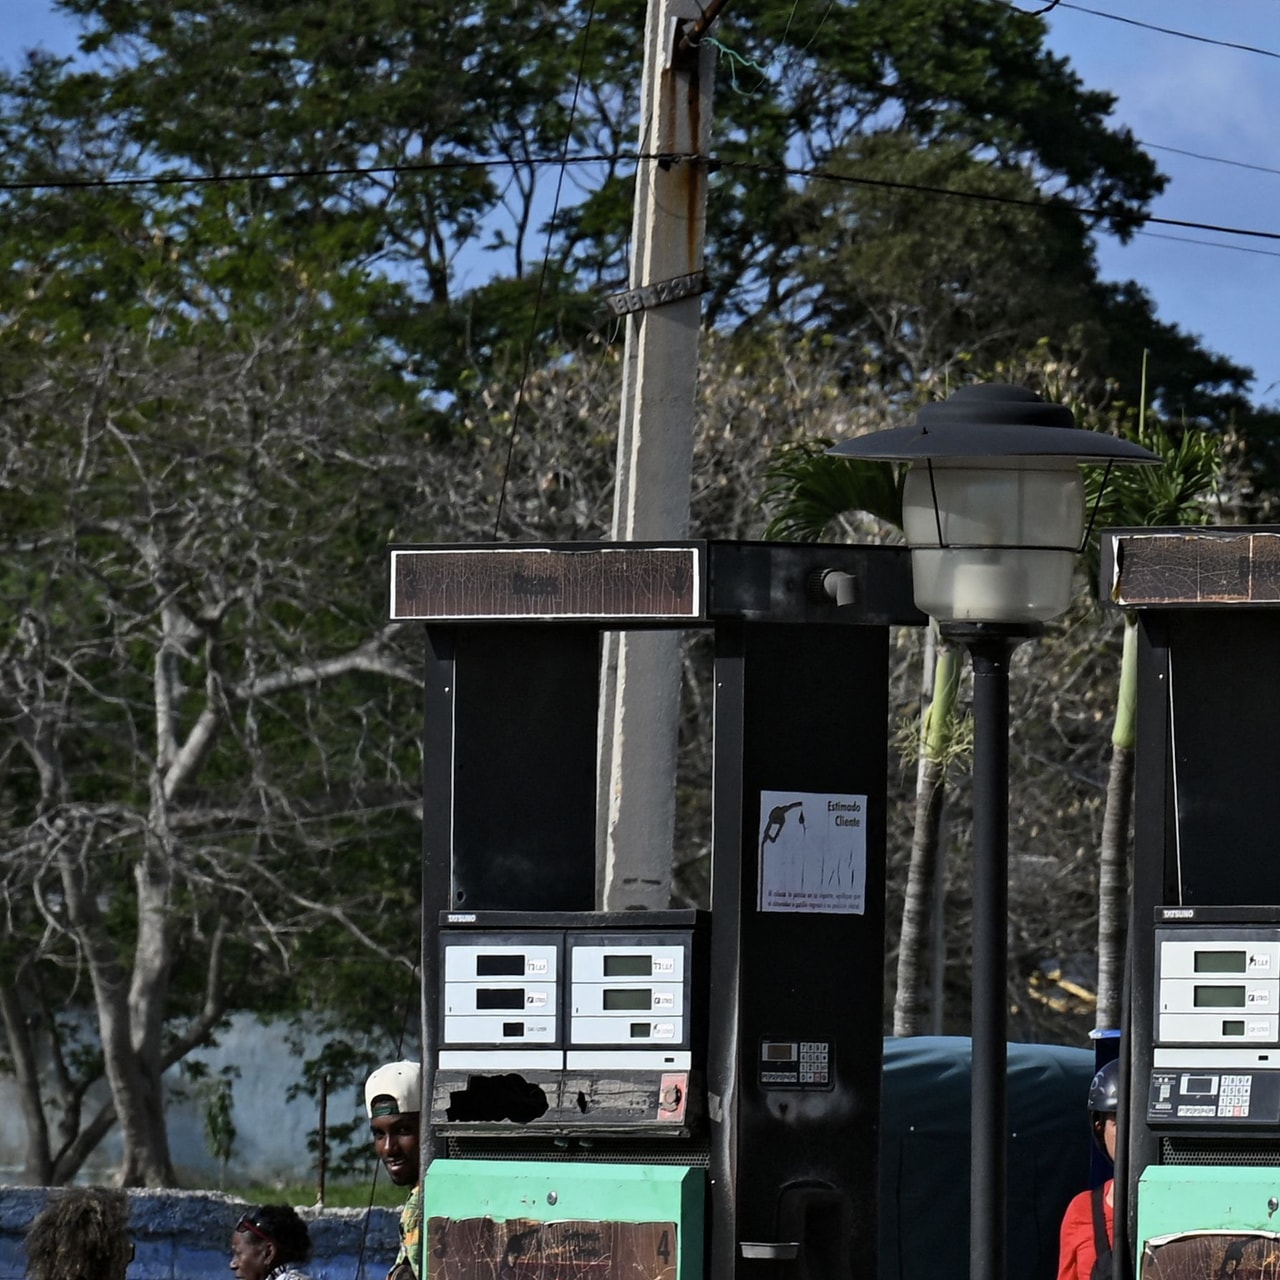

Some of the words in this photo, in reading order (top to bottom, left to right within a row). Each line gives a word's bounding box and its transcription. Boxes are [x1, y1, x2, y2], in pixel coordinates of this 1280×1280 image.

[827, 800, 861, 812] Estimado
[835, 815, 860, 827] Cliente
[657, 1229, 670, 1264] 4
